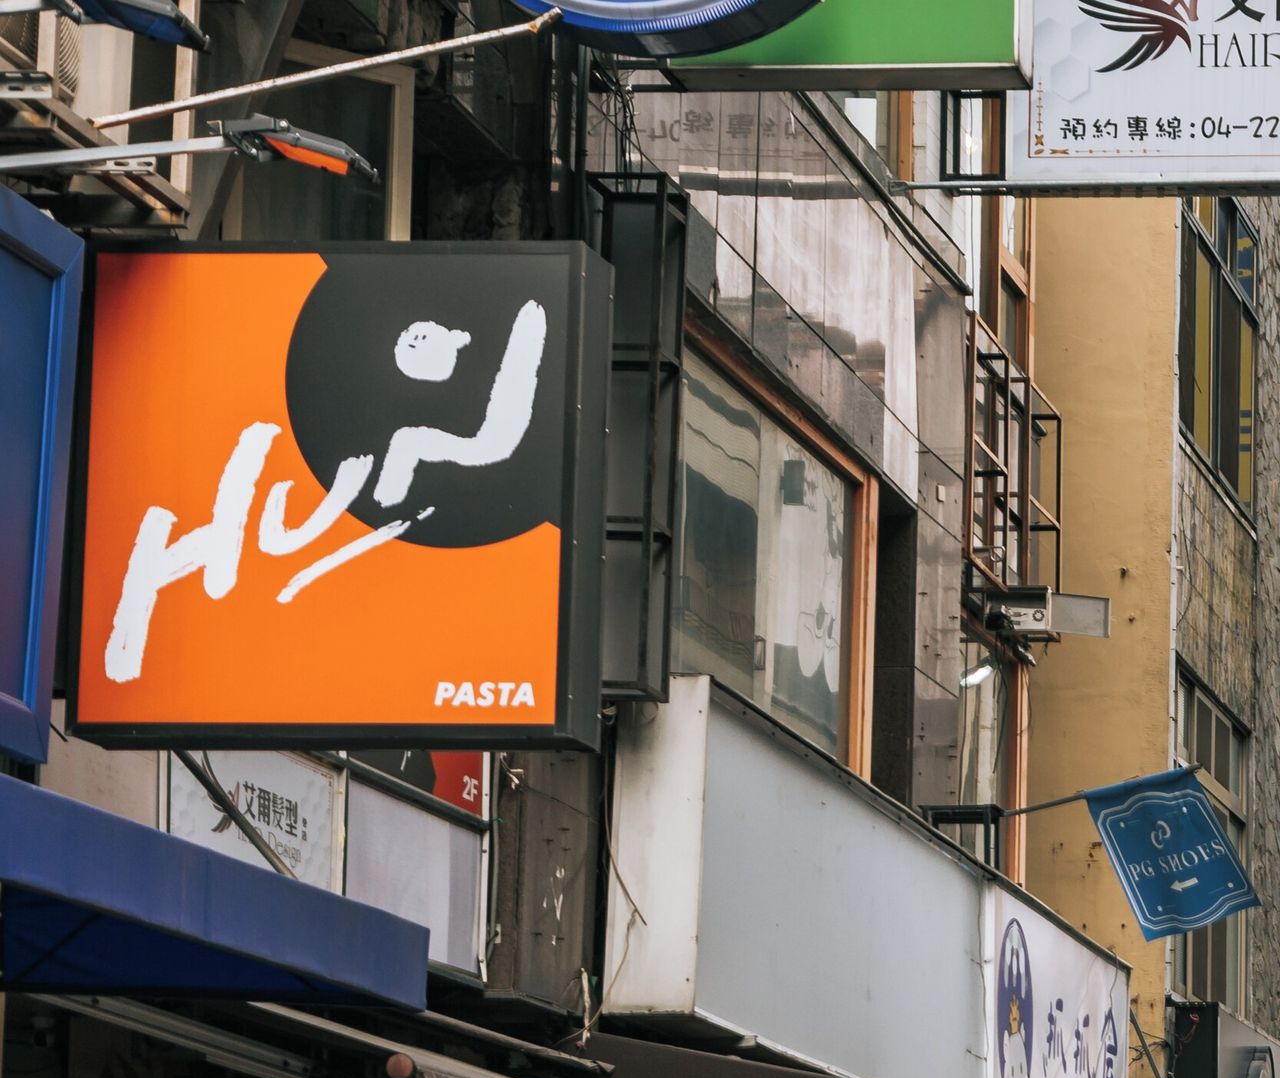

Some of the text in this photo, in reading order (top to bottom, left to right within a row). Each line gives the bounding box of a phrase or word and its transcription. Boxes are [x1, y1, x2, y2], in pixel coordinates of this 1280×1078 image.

[433, 681, 536, 708] PASTA
[462, 774, 479, 802] 2F
[1159, 838, 1226, 876] SHOES
